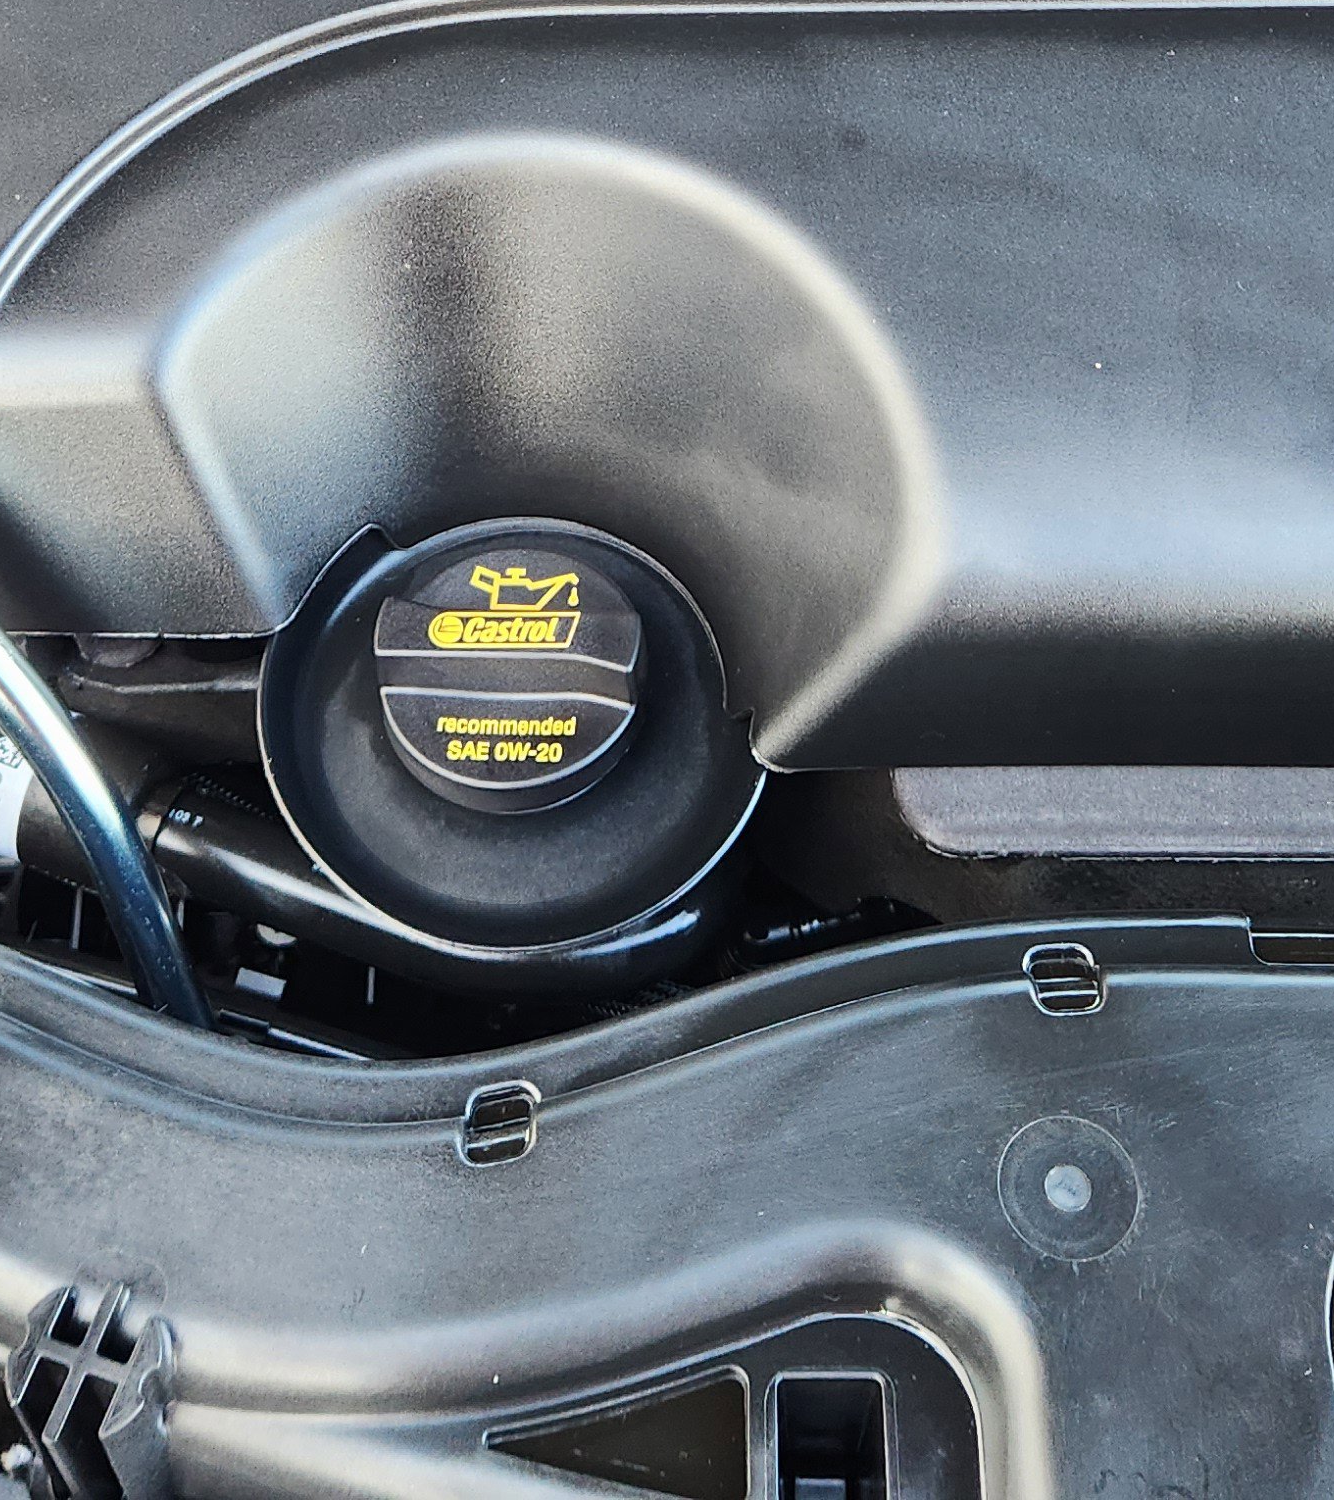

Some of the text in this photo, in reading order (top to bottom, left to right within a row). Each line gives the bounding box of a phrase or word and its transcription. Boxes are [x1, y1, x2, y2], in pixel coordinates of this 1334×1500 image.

[461, 616, 560, 644] Castrol
[435, 715, 578, 737] recommended
[445, 739, 564, 764] SAE 0W-20
